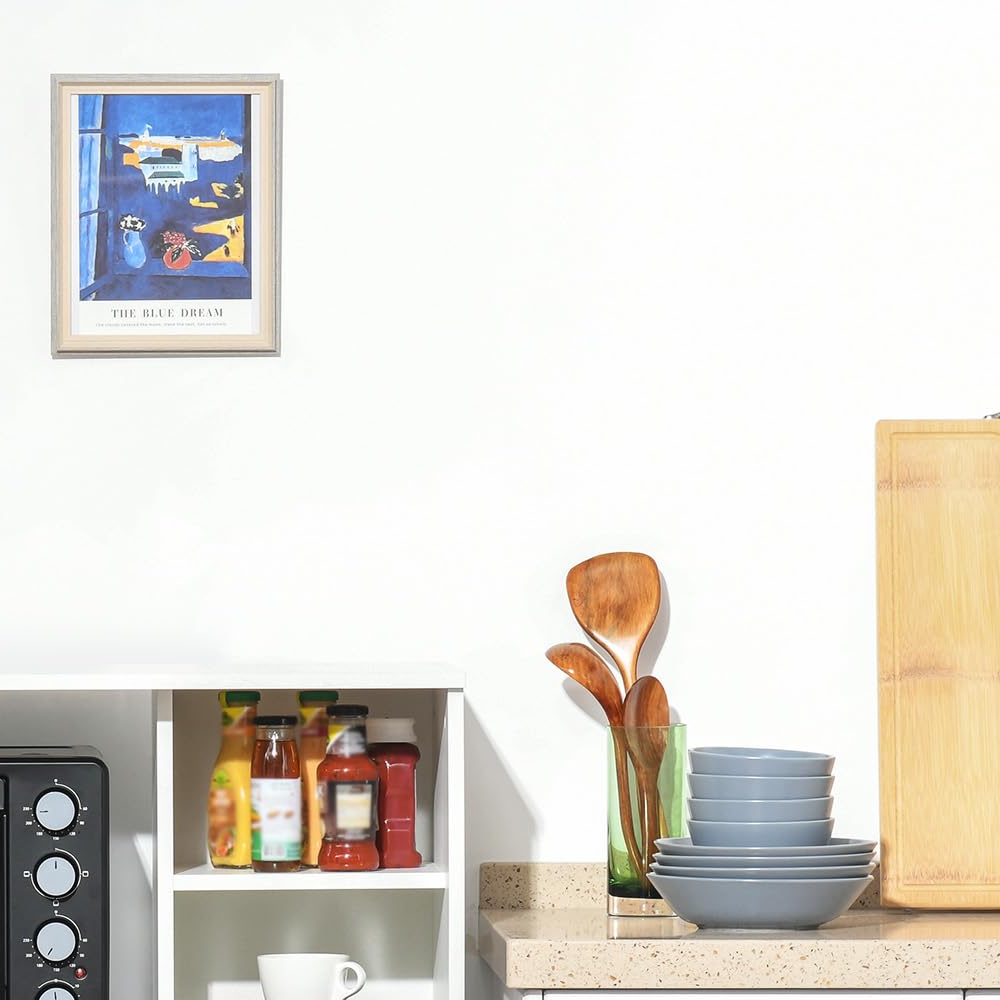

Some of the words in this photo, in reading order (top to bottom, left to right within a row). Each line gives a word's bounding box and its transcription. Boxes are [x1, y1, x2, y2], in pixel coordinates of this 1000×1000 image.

[111, 308, 137, 319] THE
[143, 308, 175, 318] BLUE
[181, 307, 223, 318] DREAM
